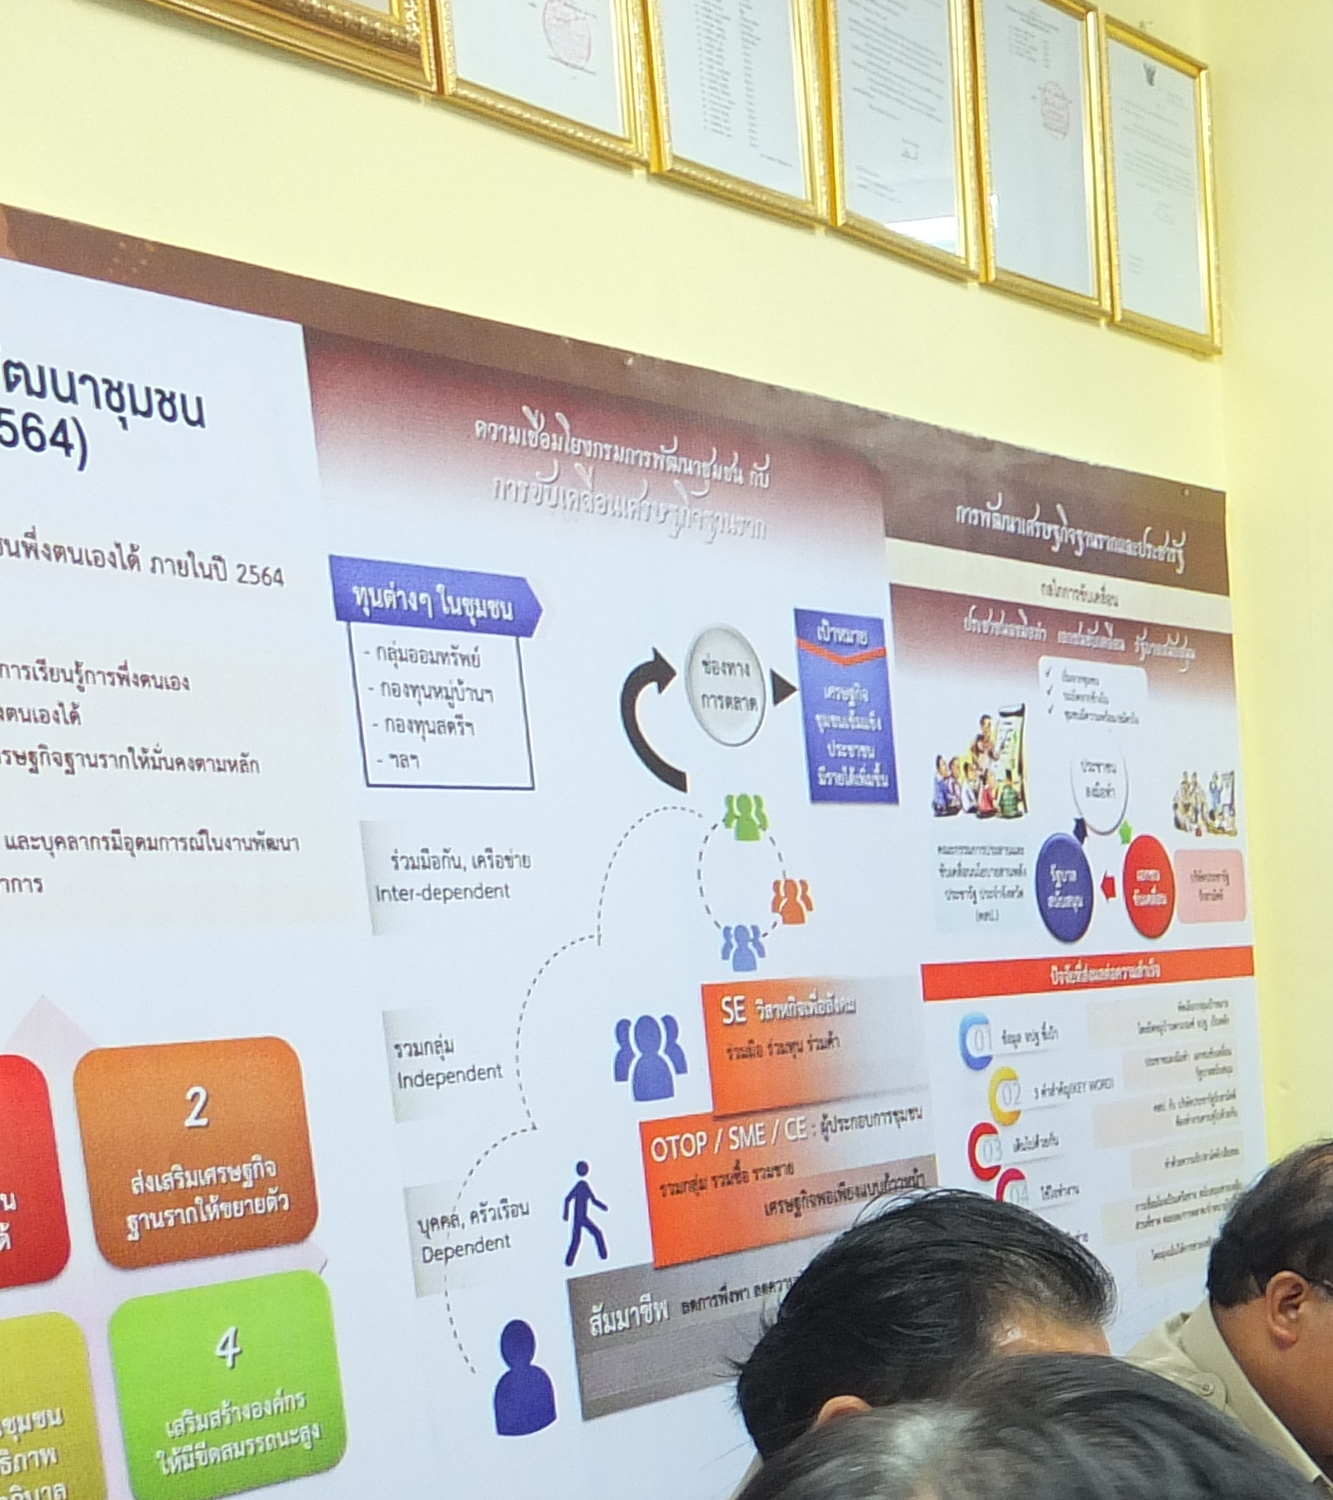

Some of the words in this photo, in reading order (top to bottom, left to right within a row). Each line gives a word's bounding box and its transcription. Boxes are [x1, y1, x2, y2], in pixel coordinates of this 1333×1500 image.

[750, 452, 771, 490] กับ
[150, 550, 228, 582] ภายในปี
[236, 562, 285, 587] 2564
[352, 581, 434, 619] ทุนต่างๆ
[435, 582, 515, 627] ในชุมชน
[376, 640, 481, 670] กลุ่มออมทรัพย์
[701, 652, 751, 678] ช่องทาง
[380, 678, 495, 710] กองทุนหมู่บ้านฯ
[700, 692, 759, 712] การตลาด
[385, 714, 476, 743] กองทุนสตรีฯ
[0, 743, 260, 776] รษฐกิจฐานรากให้มั่นคงตามหลัก
[388, 752, 421, 769] ฯลฯ
[4, 828, 301, 859] และบุคลากรมีอุดมการณ์ในงานพัฒนา
[470, 848, 532, 871] เครือข่าย
[375, 882, 512, 904] Inter-dependent
[720, 995, 748, 1026] SE
[394, 1033, 455, 1062] รวมกลุ่ม
[398, 1063, 504, 1090] Independent
[183, 1086, 209, 1128] 2
[650, 1129, 710, 1163] OTOP
[728, 1120, 767, 1151] SME
[783, 1114, 809, 1142] CE
[820, 1105, 924, 1142] ผู้ประกอบการชุมชน
[130, 1153, 278, 1196] ส่งเสริมเศรษฐกิจ
[126, 1186, 290, 1242] ฐานรากให้ขยายตัว
[469, 1197, 531, 1227] ครัวเรือน
[421, 1233, 512, 1265] Dependent
[588, 1291, 670, 1338] สัมมาชีพ
[215, 1325, 243, 1370] 4
[165, 1387, 307, 1441] เสริมสร้างองค์กร
[155, 1420, 322, 1477] ให้มีขีดสมรรถนะสูง
